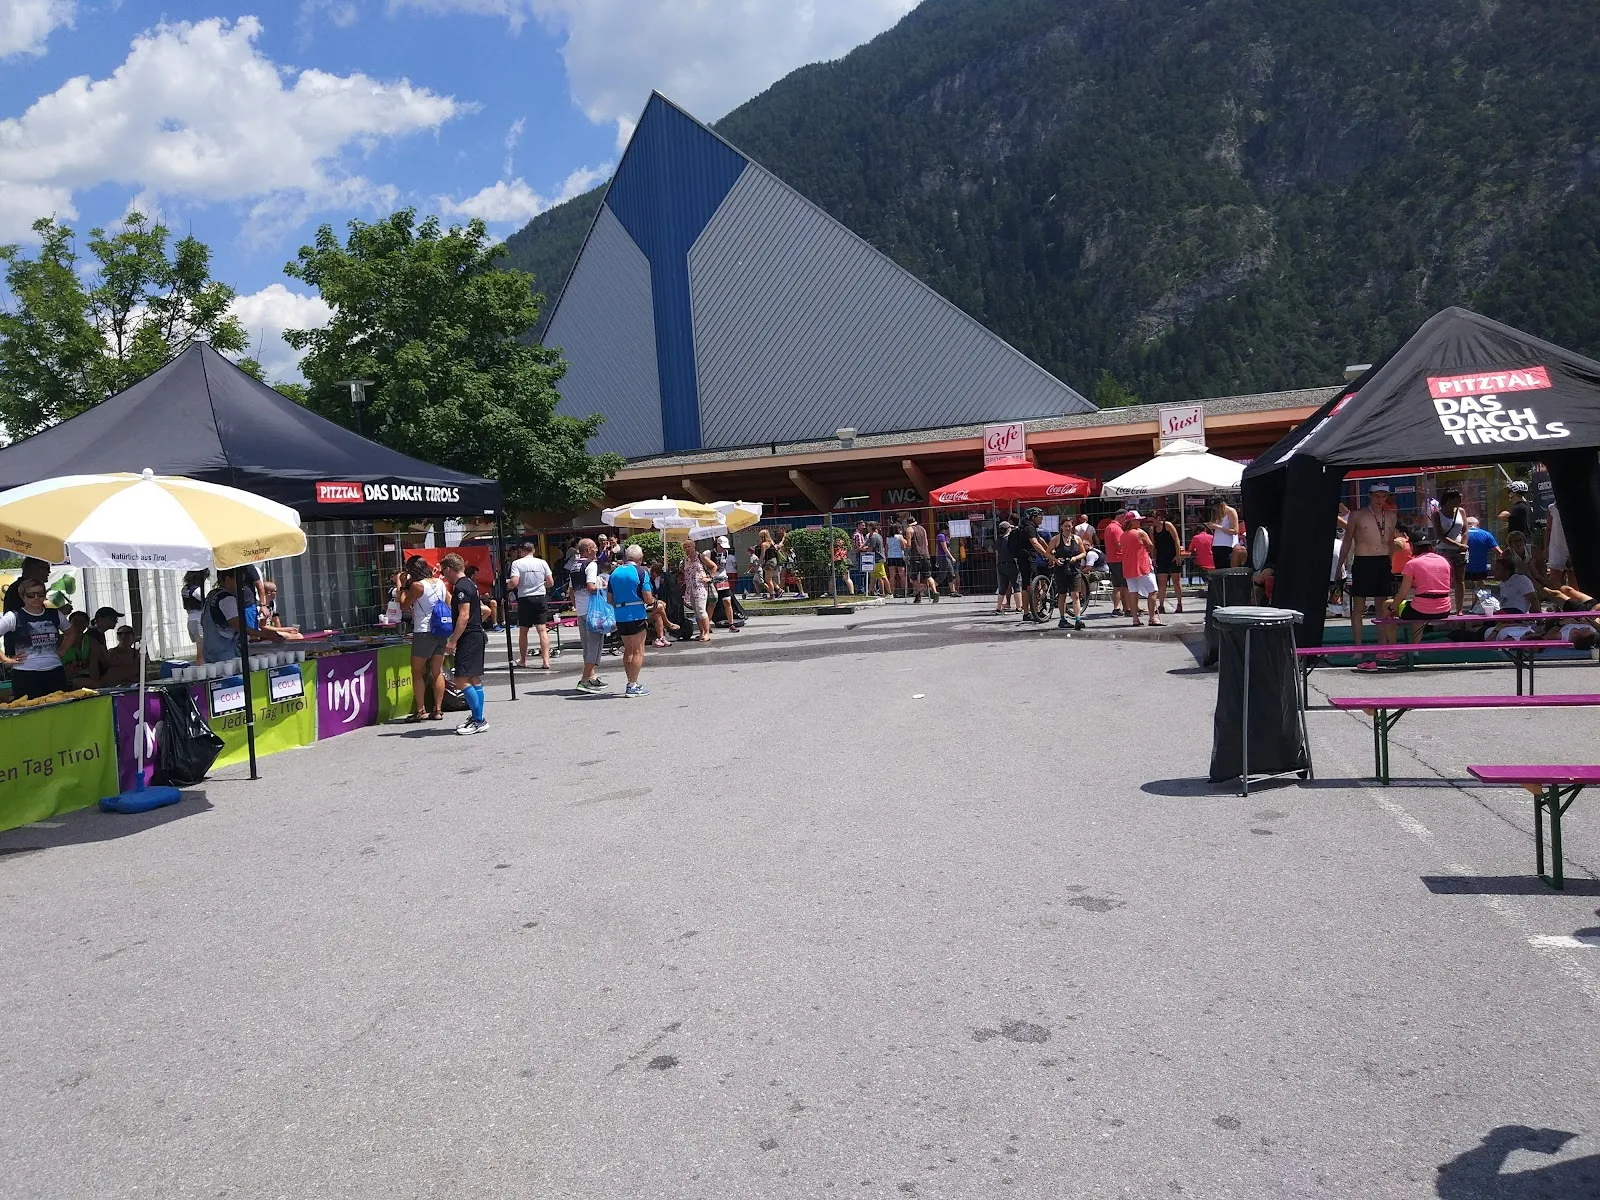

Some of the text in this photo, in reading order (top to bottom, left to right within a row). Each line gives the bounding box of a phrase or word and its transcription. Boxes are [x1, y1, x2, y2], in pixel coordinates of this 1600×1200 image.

[1438, 373, 1540, 393] PITZTAL
[1433, 394, 1502, 415] DAS
[1162, 409, 1198, 436] Susi
[1439, 407, 1538, 431] DACH
[988, 425, 1020, 451] Cafe
[1444, 421, 1571, 446] TIROLS
[320, 484, 460, 503] PITZTAL DAS DACH TIROLS
[888, 488, 916, 504] WC
[111, 552, 139, 561] Natürlich
[153, 553, 167, 562] Tirol
[277, 679, 297, 690] COLA
[387, 675, 412, 691] Jeden
[220, 691, 241, 703] COLA
[260, 707, 278, 721] Tag
[280, 696, 308, 715] Tirol
[23, 757, 54, 776] Tag
[58, 742, 100, 767] Tirol
